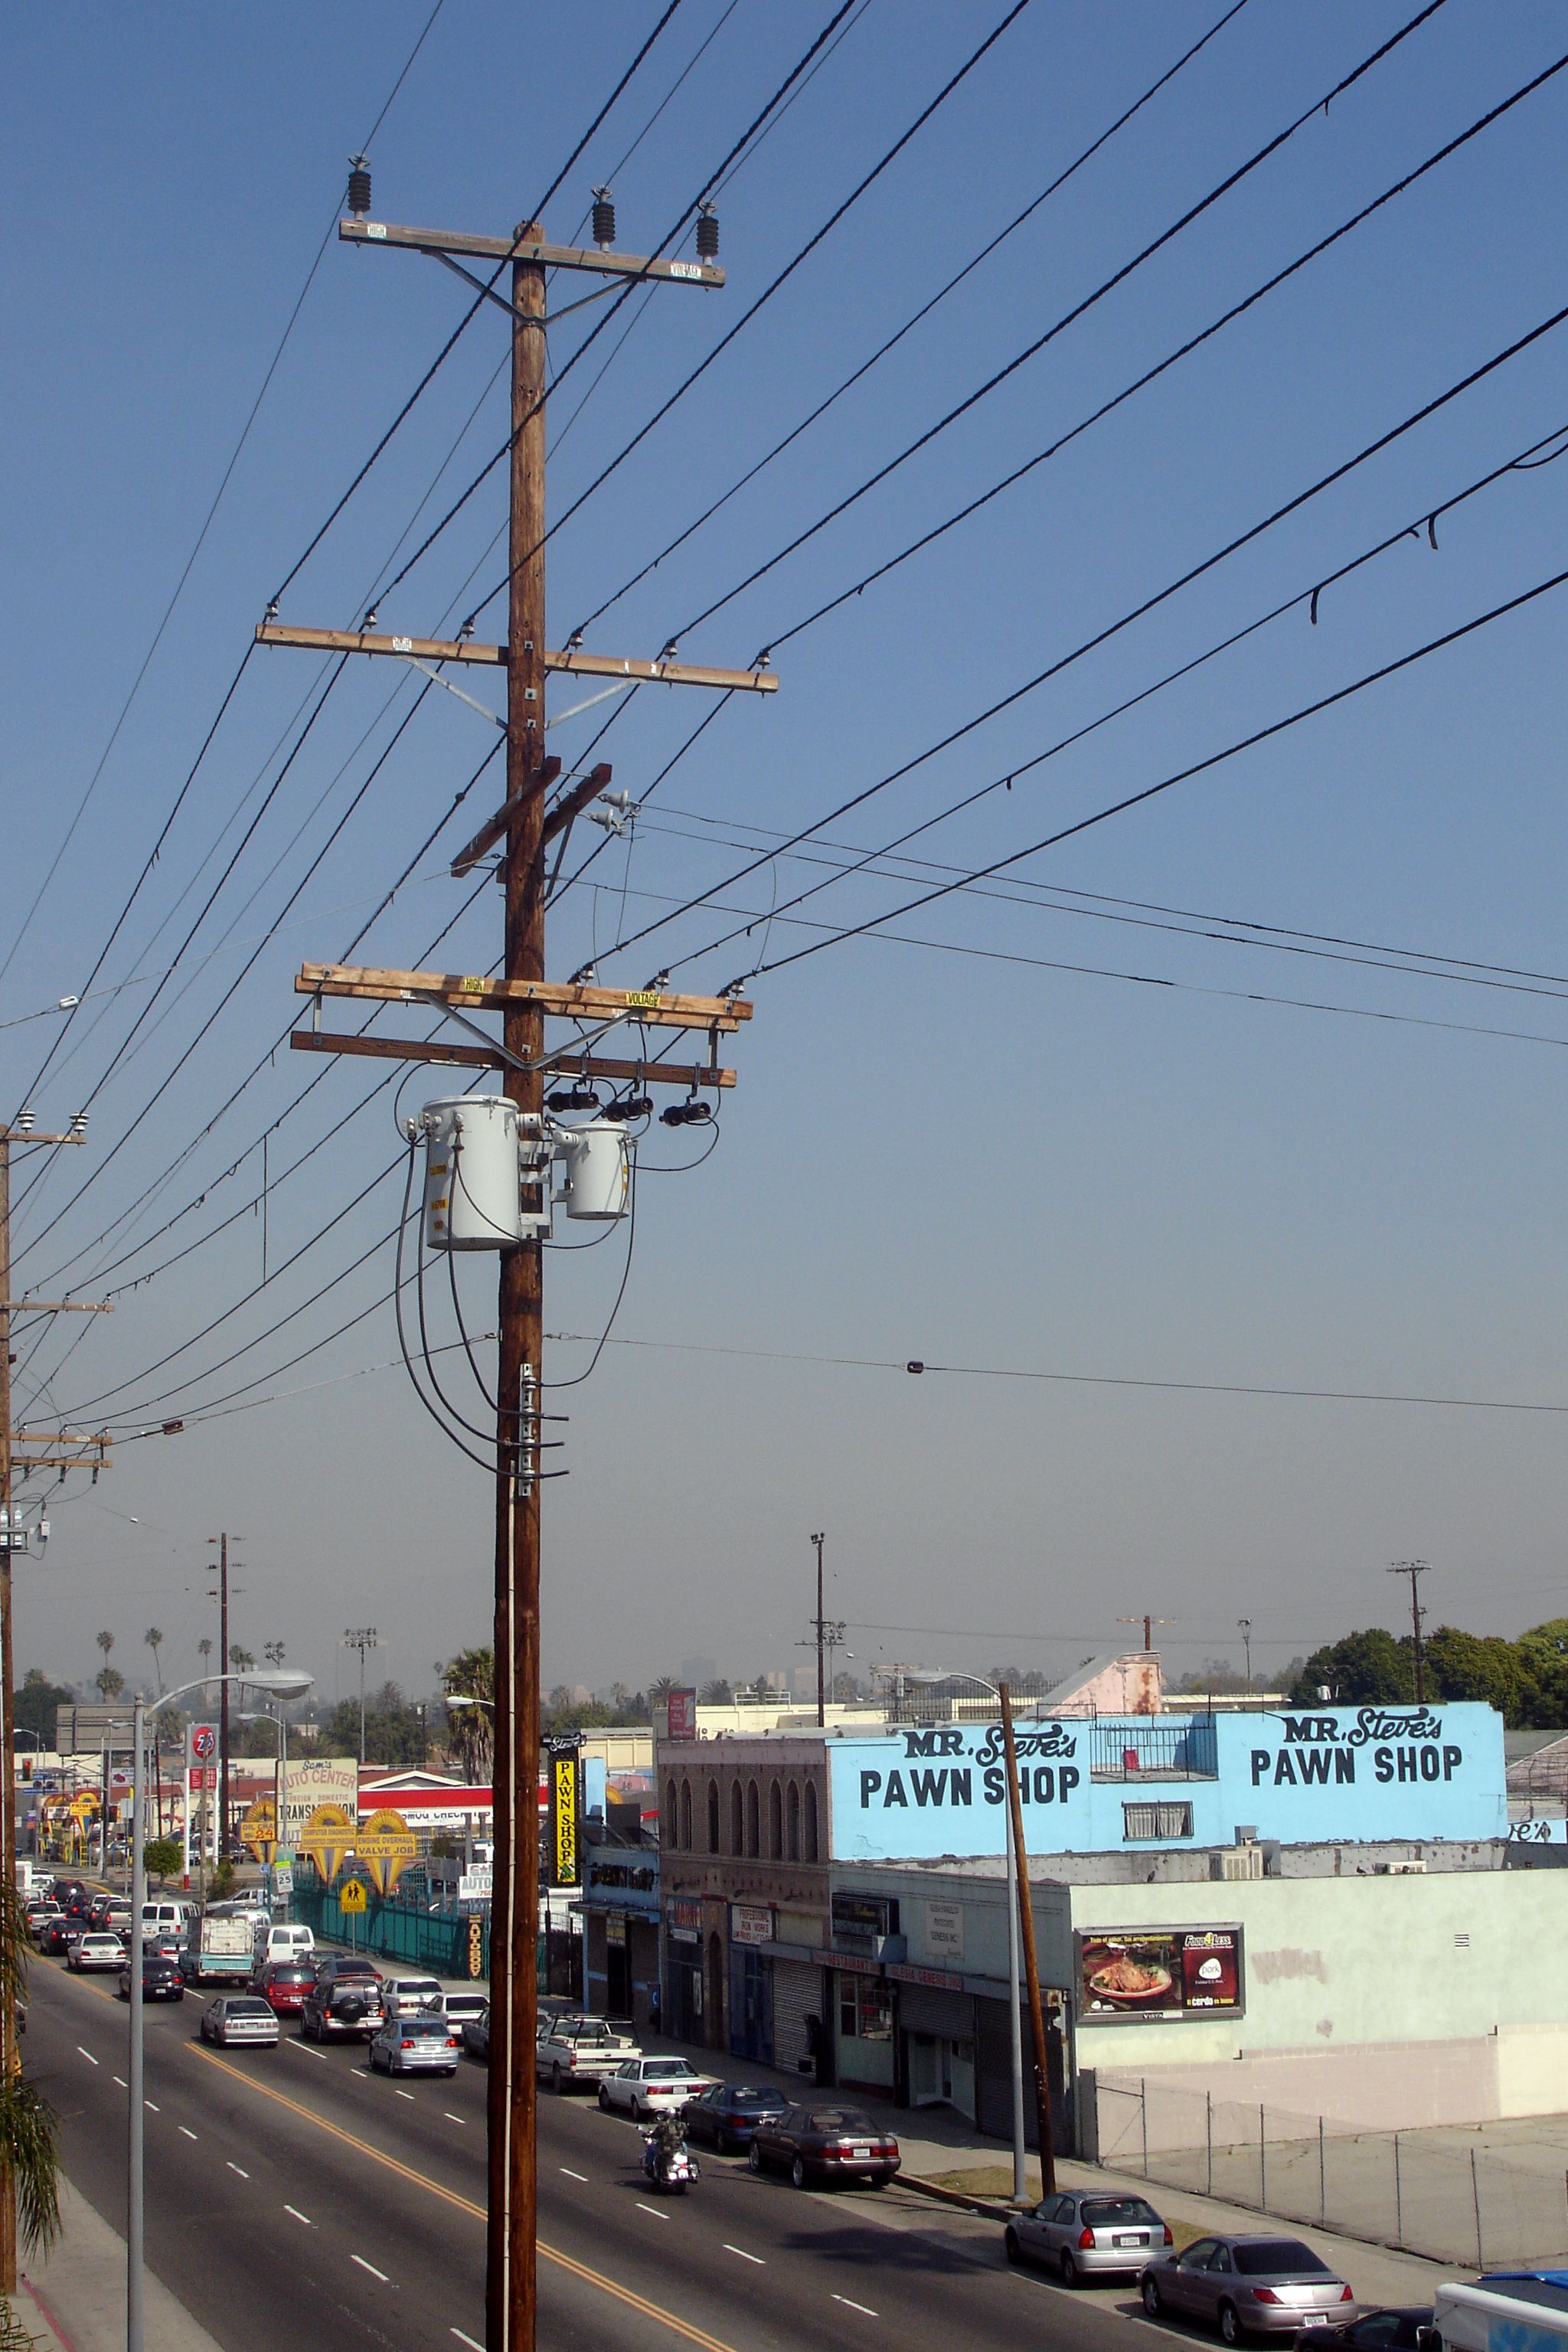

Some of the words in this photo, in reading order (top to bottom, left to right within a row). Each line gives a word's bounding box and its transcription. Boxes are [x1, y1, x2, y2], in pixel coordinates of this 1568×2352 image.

[465, 978, 483, 991] HIGH
[628, 992, 658, 1007] VOLTAGE
[1283, 1717, 1346, 1743] MR.
[1348, 1707, 1442, 1747] Steve's
[197, 1733, 215, 1752] 76
[902, 1730, 973, 1759] MR.
[302, 1760, 332, 1770] Sam's
[1250, 1748, 1355, 1786] PAWN
[1375, 1745, 1462, 1782] SHOP
[279, 1771, 309, 1791] AUTO
[312, 1769, 356, 1789] CENTER
[558, 1763, 573, 1809] PAWN
[861, 1768, 972, 1808] PAWN
[984, 1766, 1080, 1805] SHOP
[561, 1815, 572, 1861] SHOP
[279, 1876, 291, 1884] 25
[462, 1877, 492, 1890] AUTO
[469, 1923, 482, 1977] AUTOBODY
[1202, 1965, 1220, 1975] pork
[1191, 1996, 1214, 2006] cerdo
